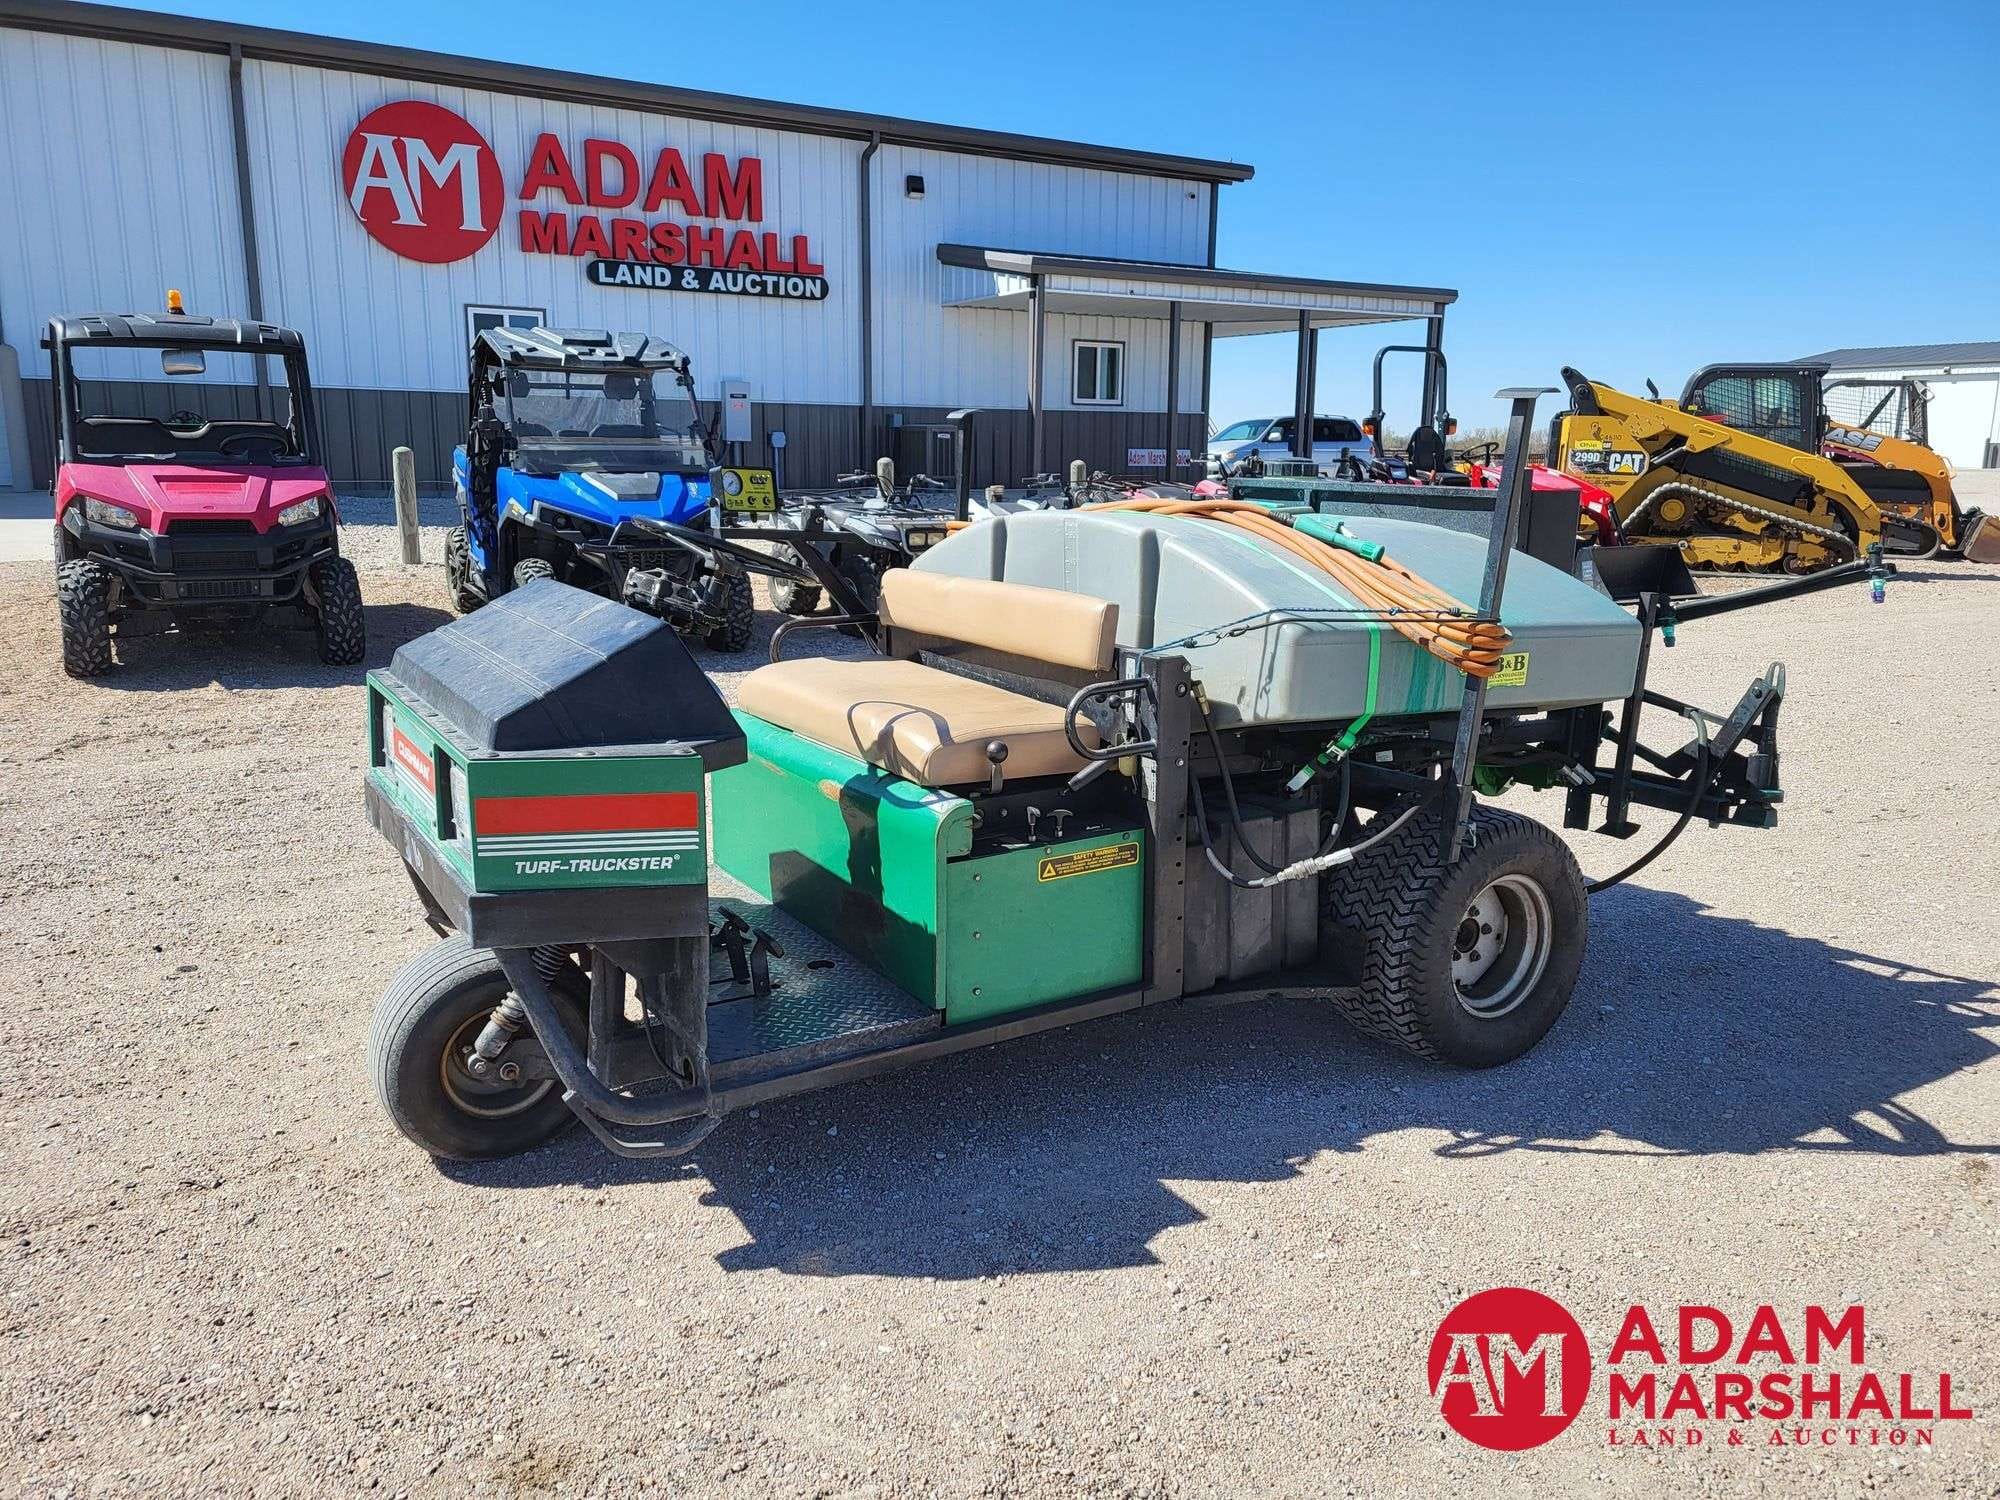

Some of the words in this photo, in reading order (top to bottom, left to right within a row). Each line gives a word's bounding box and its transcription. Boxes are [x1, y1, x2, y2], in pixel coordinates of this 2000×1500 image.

[349, 131, 488, 232] AM
[519, 132, 763, 222] ADAM
[519, 210, 824, 274] MARSHALL
[598, 262, 671, 288] LAND
[680, 268, 700, 290] &
[708, 269, 823, 297] AUCTION
[1574, 452, 1600, 462] 299D
[1608, 453, 1644, 473] CAT
[1825, 427, 1884, 451] ASE
